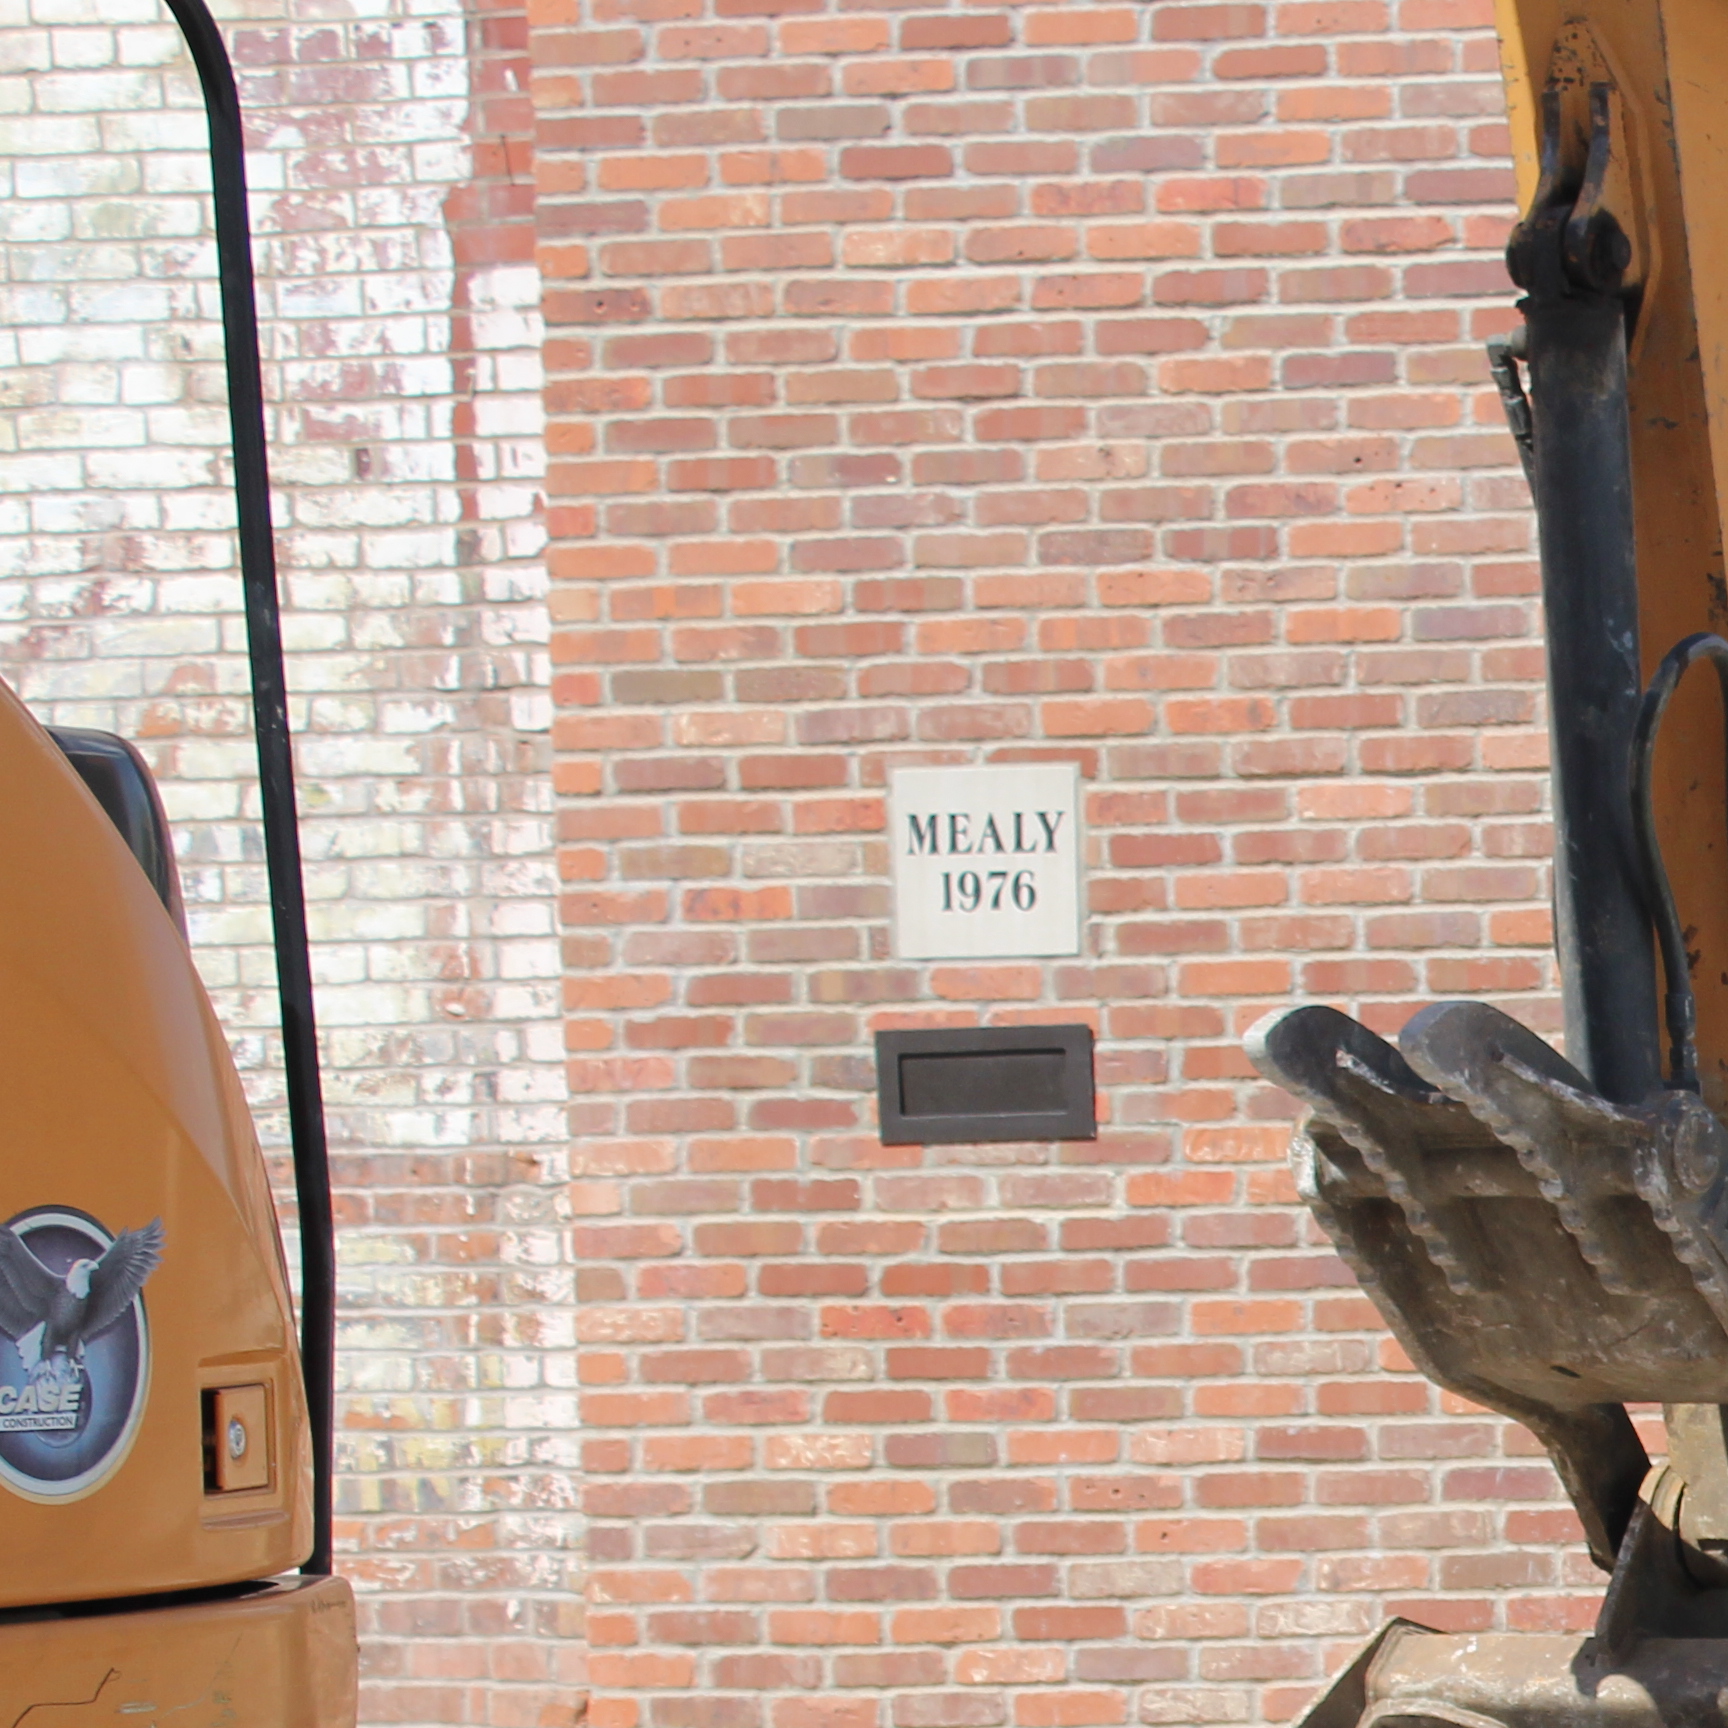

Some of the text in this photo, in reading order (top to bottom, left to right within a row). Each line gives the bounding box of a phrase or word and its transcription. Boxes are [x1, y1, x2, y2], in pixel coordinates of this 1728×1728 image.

[906, 810, 1067, 856] MEALY
[941, 870, 1038, 913] 1976
[0, 1383, 83, 1415] CASE
[3, 1415, 75, 1429] CONSTRUCTION
